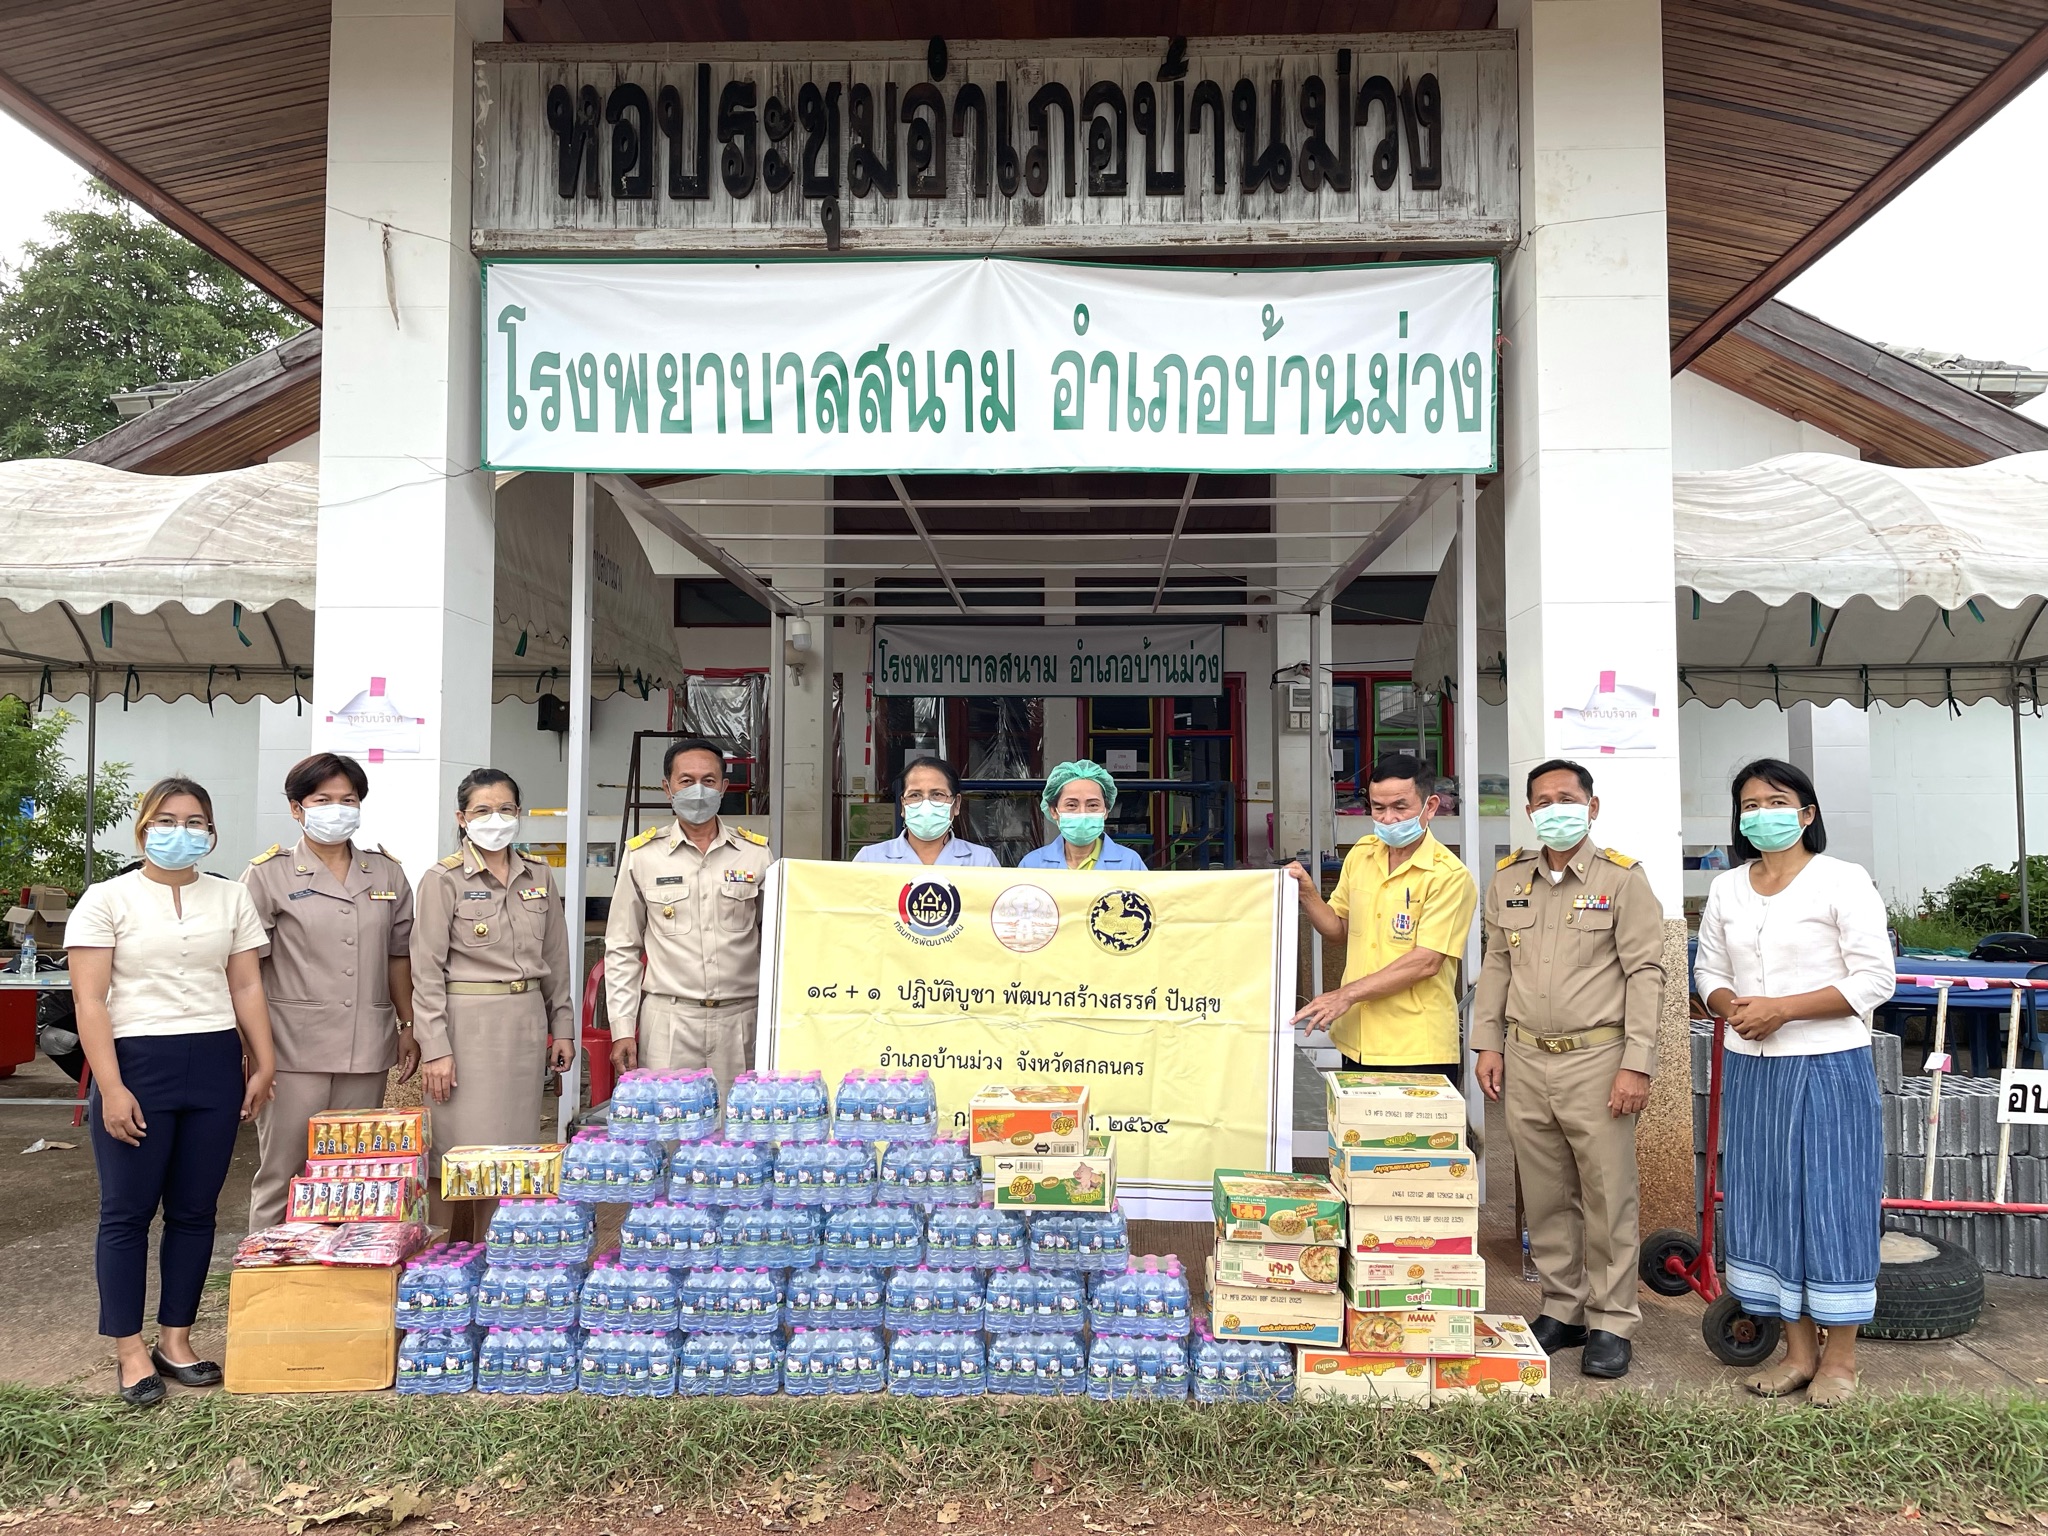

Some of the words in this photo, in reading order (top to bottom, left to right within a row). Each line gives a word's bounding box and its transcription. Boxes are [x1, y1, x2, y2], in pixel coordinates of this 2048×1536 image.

[497, 304, 1016, 435] โรงพยาบาลสนาม
[1052, 302, 1483, 436] อำเภอบ้านม่วง
[878, 639, 1057, 683] โรงพยาบาลสนาม
[1070, 636, 1219, 683] อำเภอบ้านม่วง
[348, 712, 403, 726] จุดรับบริจาค
[1580, 707, 1637, 721] จุดรับบริจาค
[894, 921, 964, 947] กรมการพัฒนาชุมชน
[807, 983, 838, 999] ๑๘
[845, 985, 859, 999] +
[867, 988, 881, 1000] ๑
[897, 978, 995, 1011] ปฏิบัติบูชา
[1002, 981, 1158, 1010] พัฒนาสร้างสรรค์
[1165, 988, 1221, 1021] ปันสุข
[879, 1046, 1003, 1071] อำเภอบ้านม่วง
[1015, 1050, 1145, 1076] จังหวัดสกลนคร
[1108, 1115, 1170, 1135] ๒๕๖๔
[1406, 1290, 1431, 1302] รสสุกี้
[1407, 1314, 1436, 1322] MAMA
